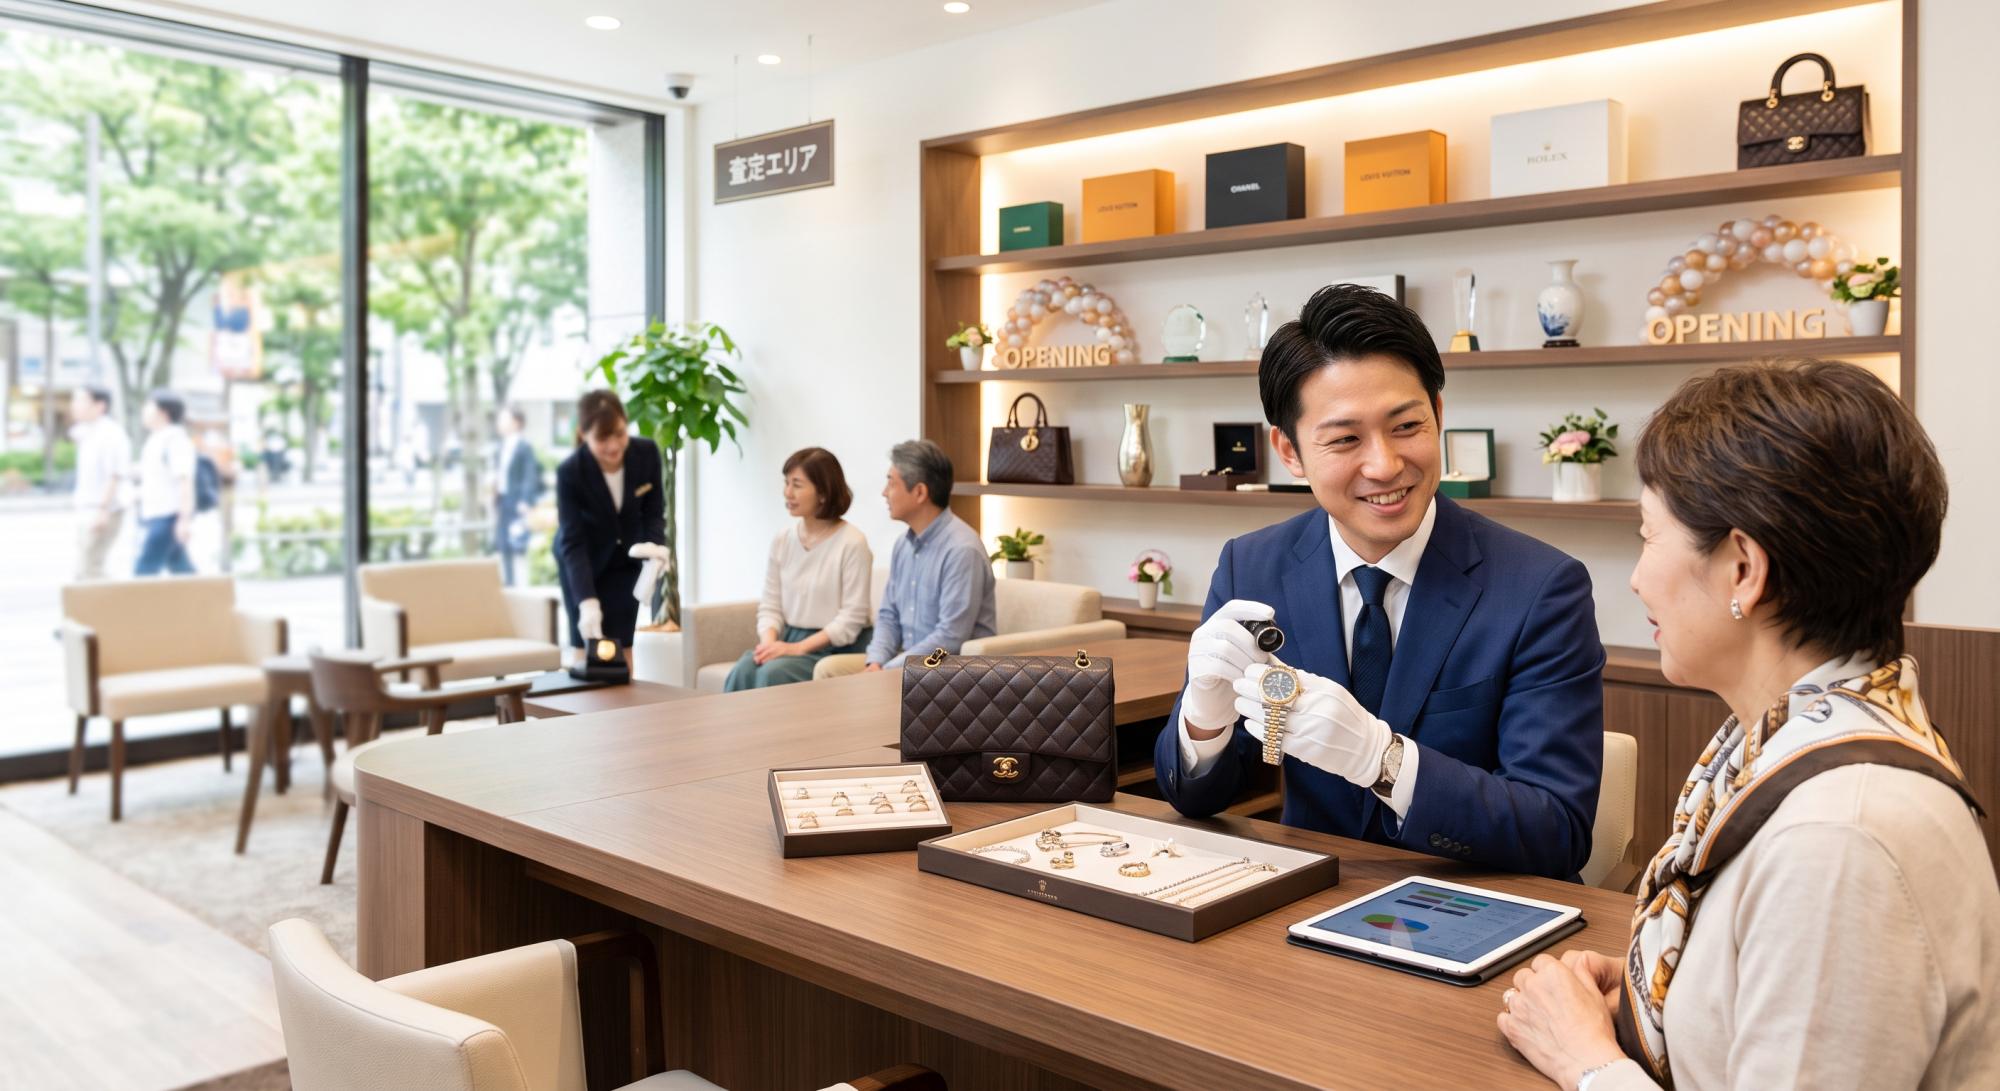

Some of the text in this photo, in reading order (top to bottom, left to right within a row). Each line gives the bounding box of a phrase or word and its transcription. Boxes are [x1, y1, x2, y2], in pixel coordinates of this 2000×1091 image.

[728, 144, 817, 186] 査定エリア
[1648, 307, 1826, 345] OPENING
[1004, 344, 1112, 370] OPENING
